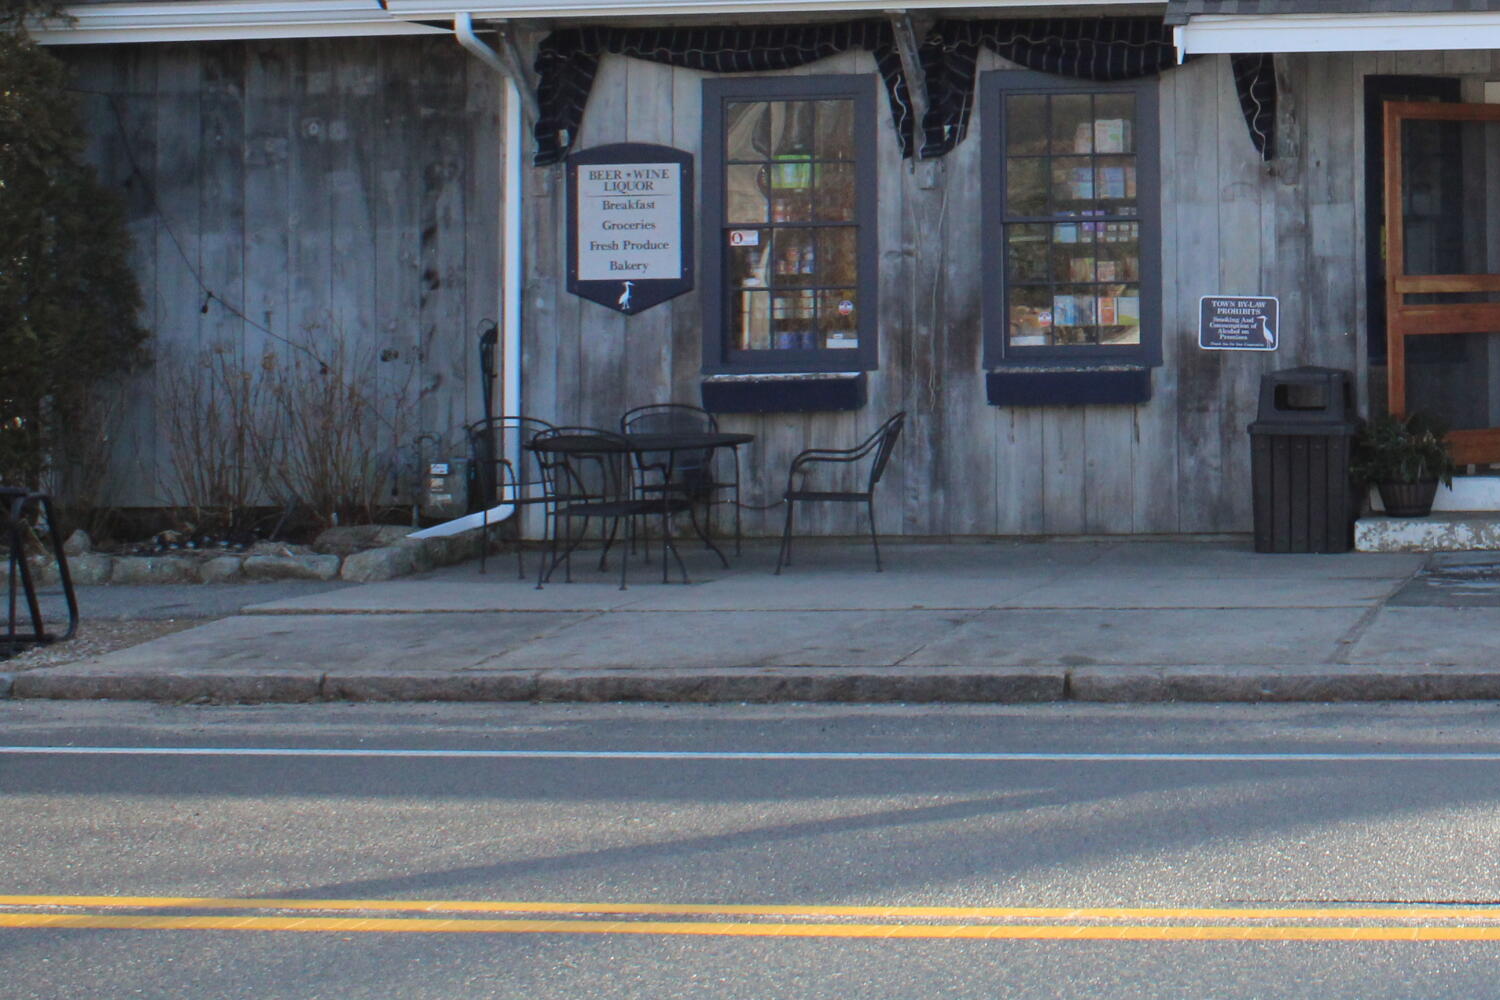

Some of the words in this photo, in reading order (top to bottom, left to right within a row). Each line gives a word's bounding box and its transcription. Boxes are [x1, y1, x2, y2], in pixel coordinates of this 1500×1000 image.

[589, 170, 622, 180] BEER
[633, 169, 670, 179] WINE
[604, 181, 654, 193] LIQUOR
[602, 200, 656, 210] Breakfast
[602, 220, 656, 231] Groceries
[590, 241, 619, 251] Fresh
[623, 240, 670, 250] Produce
[610, 261, 649, 273] Bakery
[1238, 300, 1266, 308] BY-LAW
